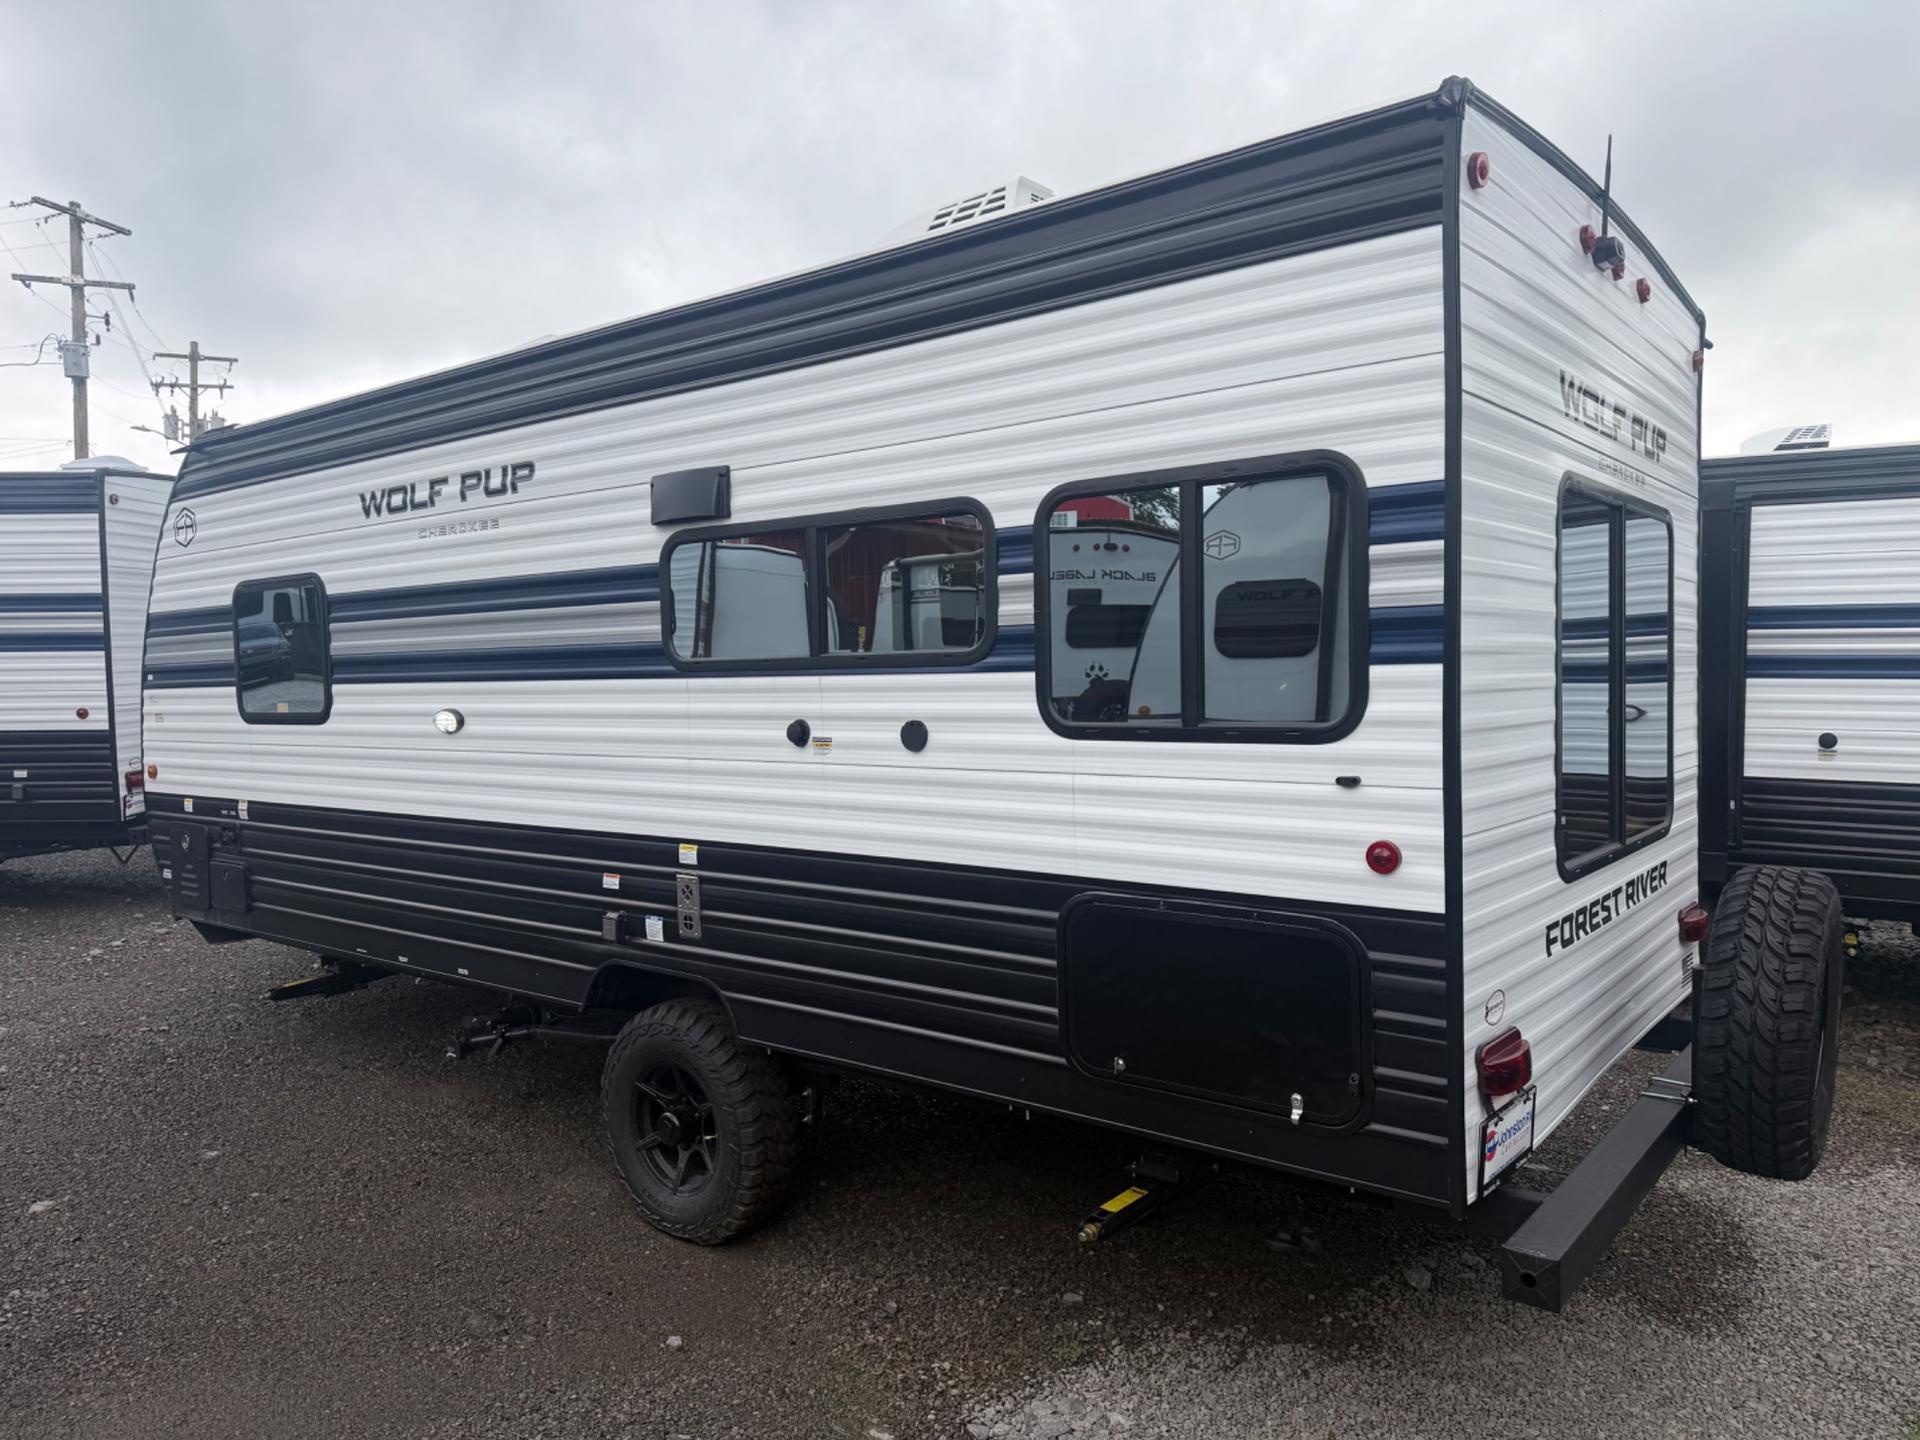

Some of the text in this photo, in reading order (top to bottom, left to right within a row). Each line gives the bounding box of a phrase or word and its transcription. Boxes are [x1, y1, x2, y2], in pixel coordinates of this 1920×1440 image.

[1559, 369, 1667, 464] WOLF PUP
[358, 460, 536, 519] WOLF PUP
[417, 518, 500, 539] CHEROKEE
[1545, 860, 1668, 958] FOREST RIVER
